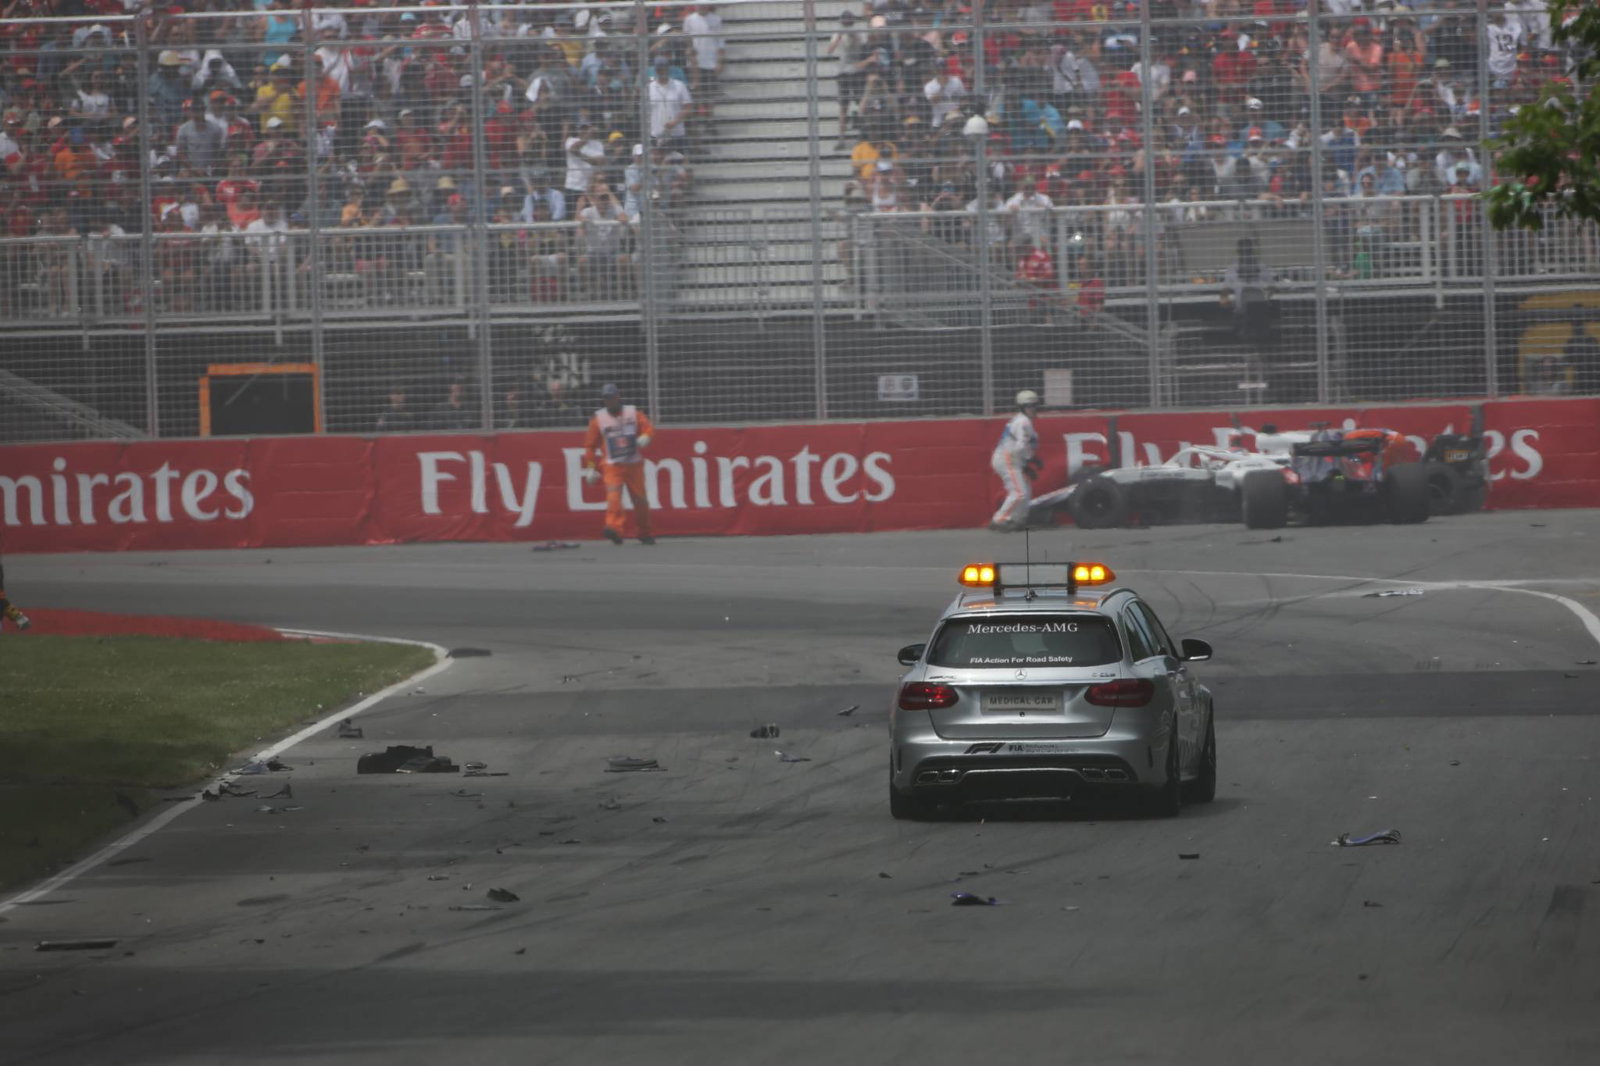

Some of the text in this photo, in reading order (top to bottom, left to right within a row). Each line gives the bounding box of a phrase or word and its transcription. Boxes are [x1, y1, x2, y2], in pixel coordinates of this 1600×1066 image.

[416, 450, 543, 528] Fly
[562, 440, 896, 512] Emirates
[967, 622, 1079, 634] Mercedes-AMG
[1048, 655, 1073, 663] Safety
[989, 696, 1054, 705] MEDICAL CAR
[1009, 744, 1024, 752] FIA
